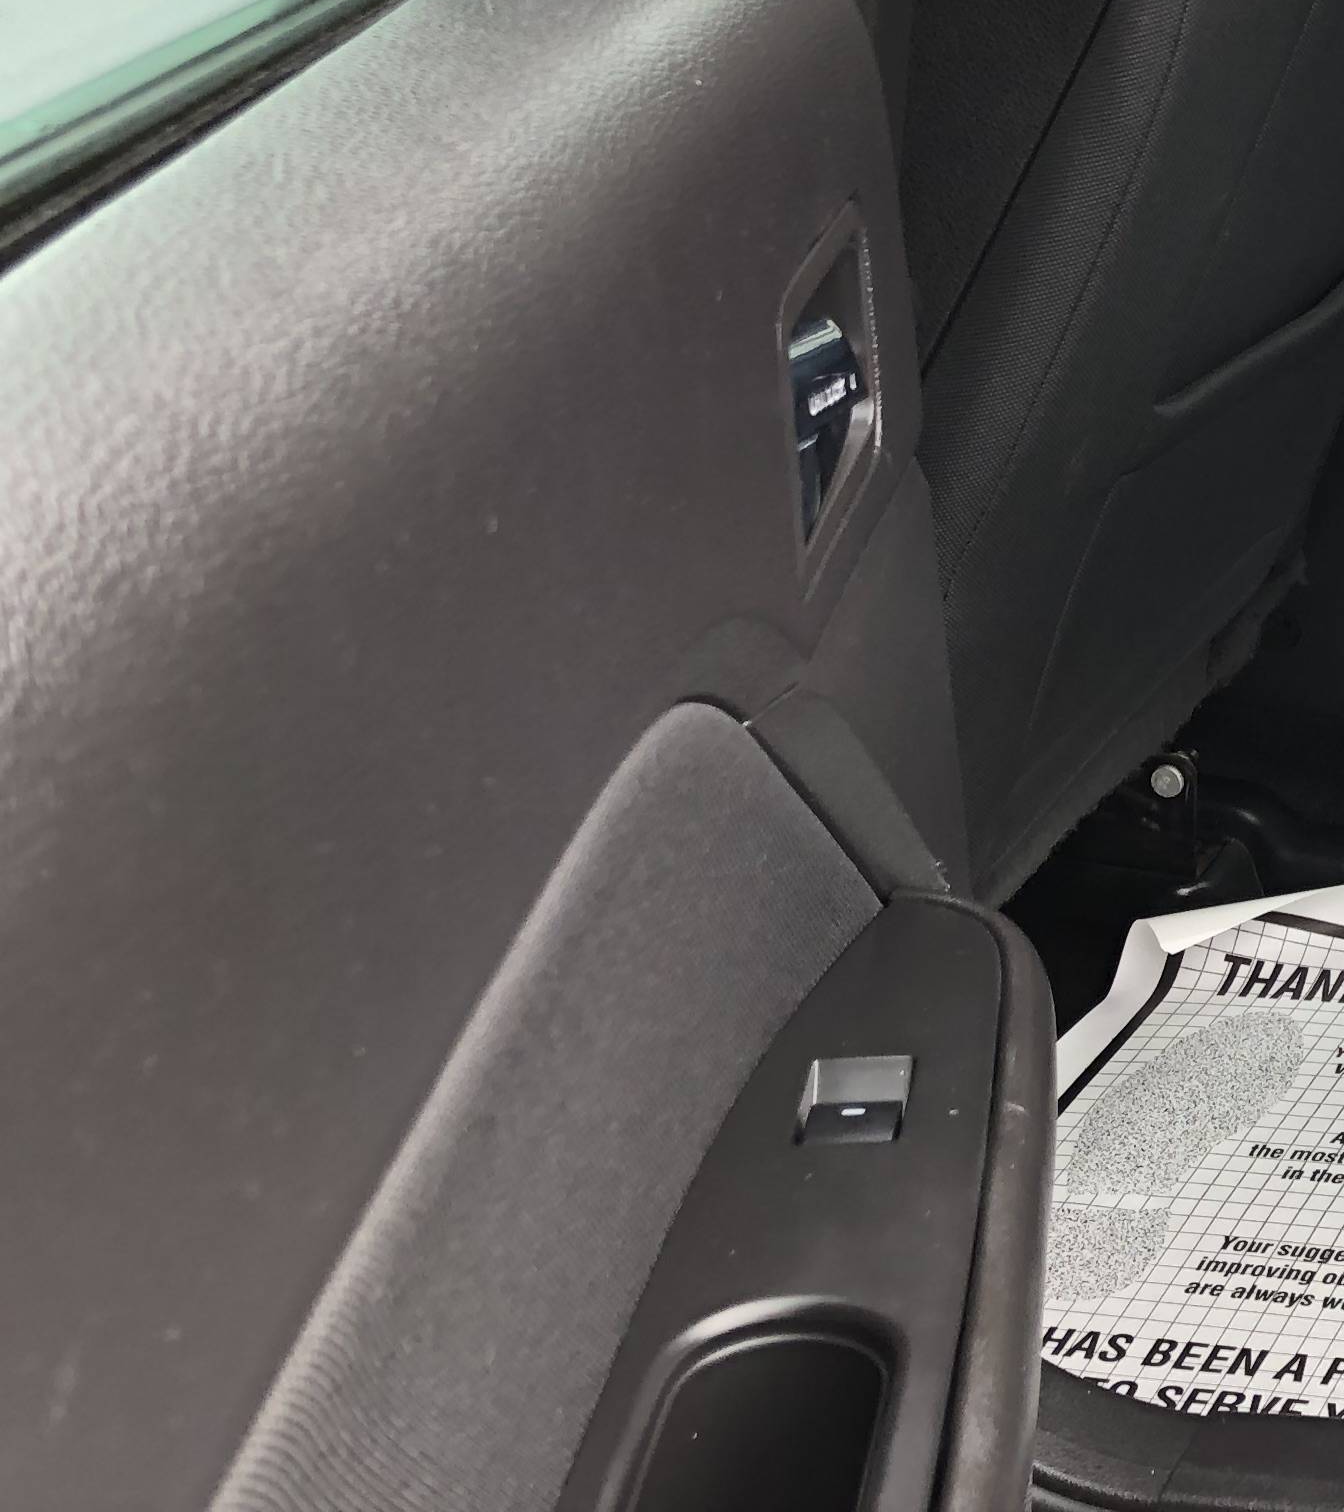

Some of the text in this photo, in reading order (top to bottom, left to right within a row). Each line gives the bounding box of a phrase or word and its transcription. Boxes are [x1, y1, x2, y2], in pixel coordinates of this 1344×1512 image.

[1248, 1144, 1284, 1159] the
[1281, 1166, 1304, 1180] in
[1220, 1235, 1274, 1254] Your
[1195, 1256, 1316, 1285] improving
[1184, 1280, 1225, 1297] are
[1230, 1283, 1315, 1308] always
[1043, 1327, 1134, 1362] HAS
[1141, 1338, 1269, 1376] BEEN
[1272, 1353, 1309, 1383] A
